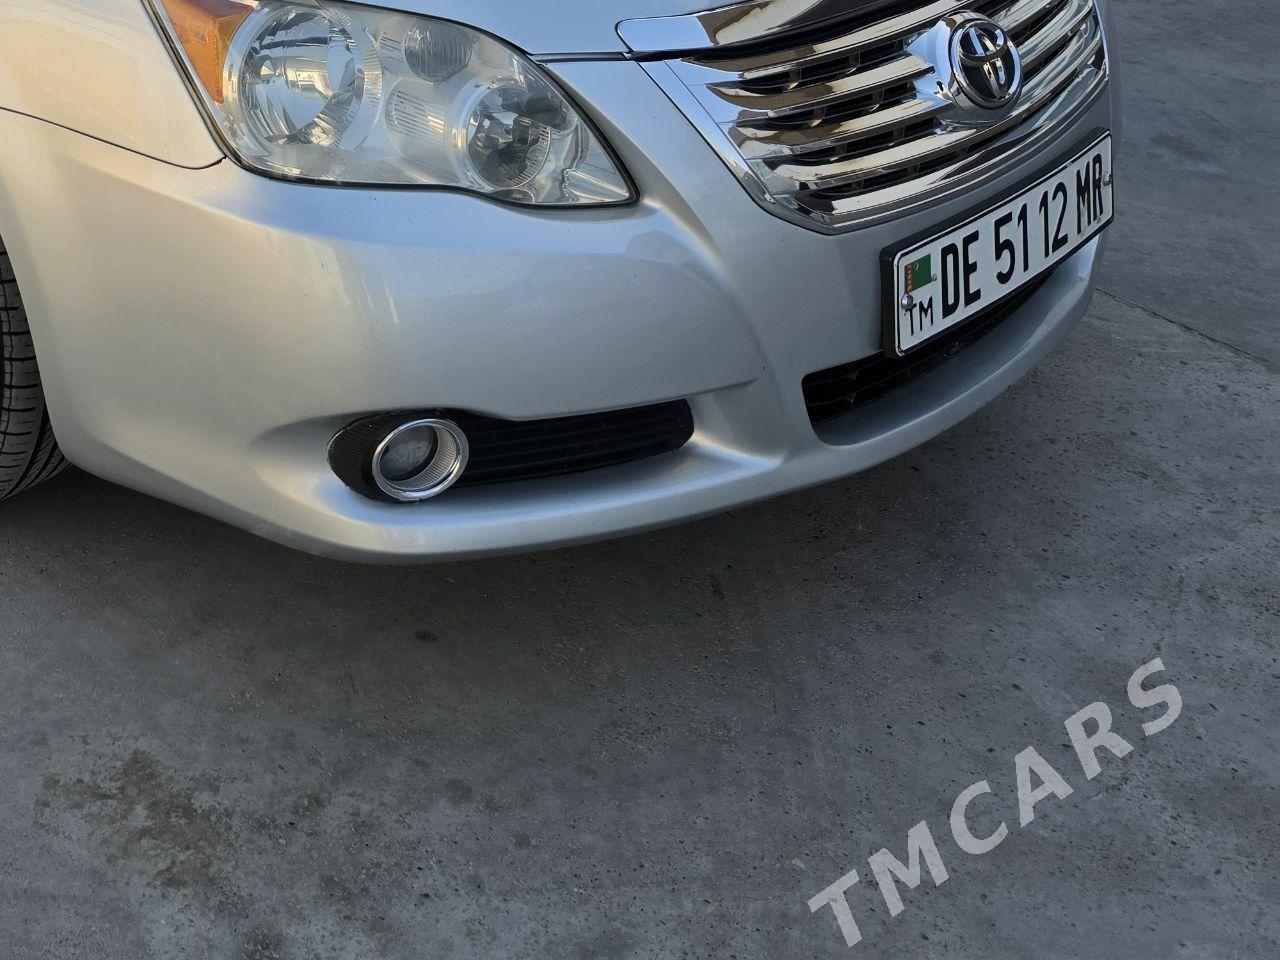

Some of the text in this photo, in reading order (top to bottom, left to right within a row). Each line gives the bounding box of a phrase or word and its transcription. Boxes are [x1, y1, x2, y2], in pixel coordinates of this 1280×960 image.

[940, 230, 981, 319] DE
[1076, 153, 1104, 236] MR
[904, 296, 934, 336] TM
